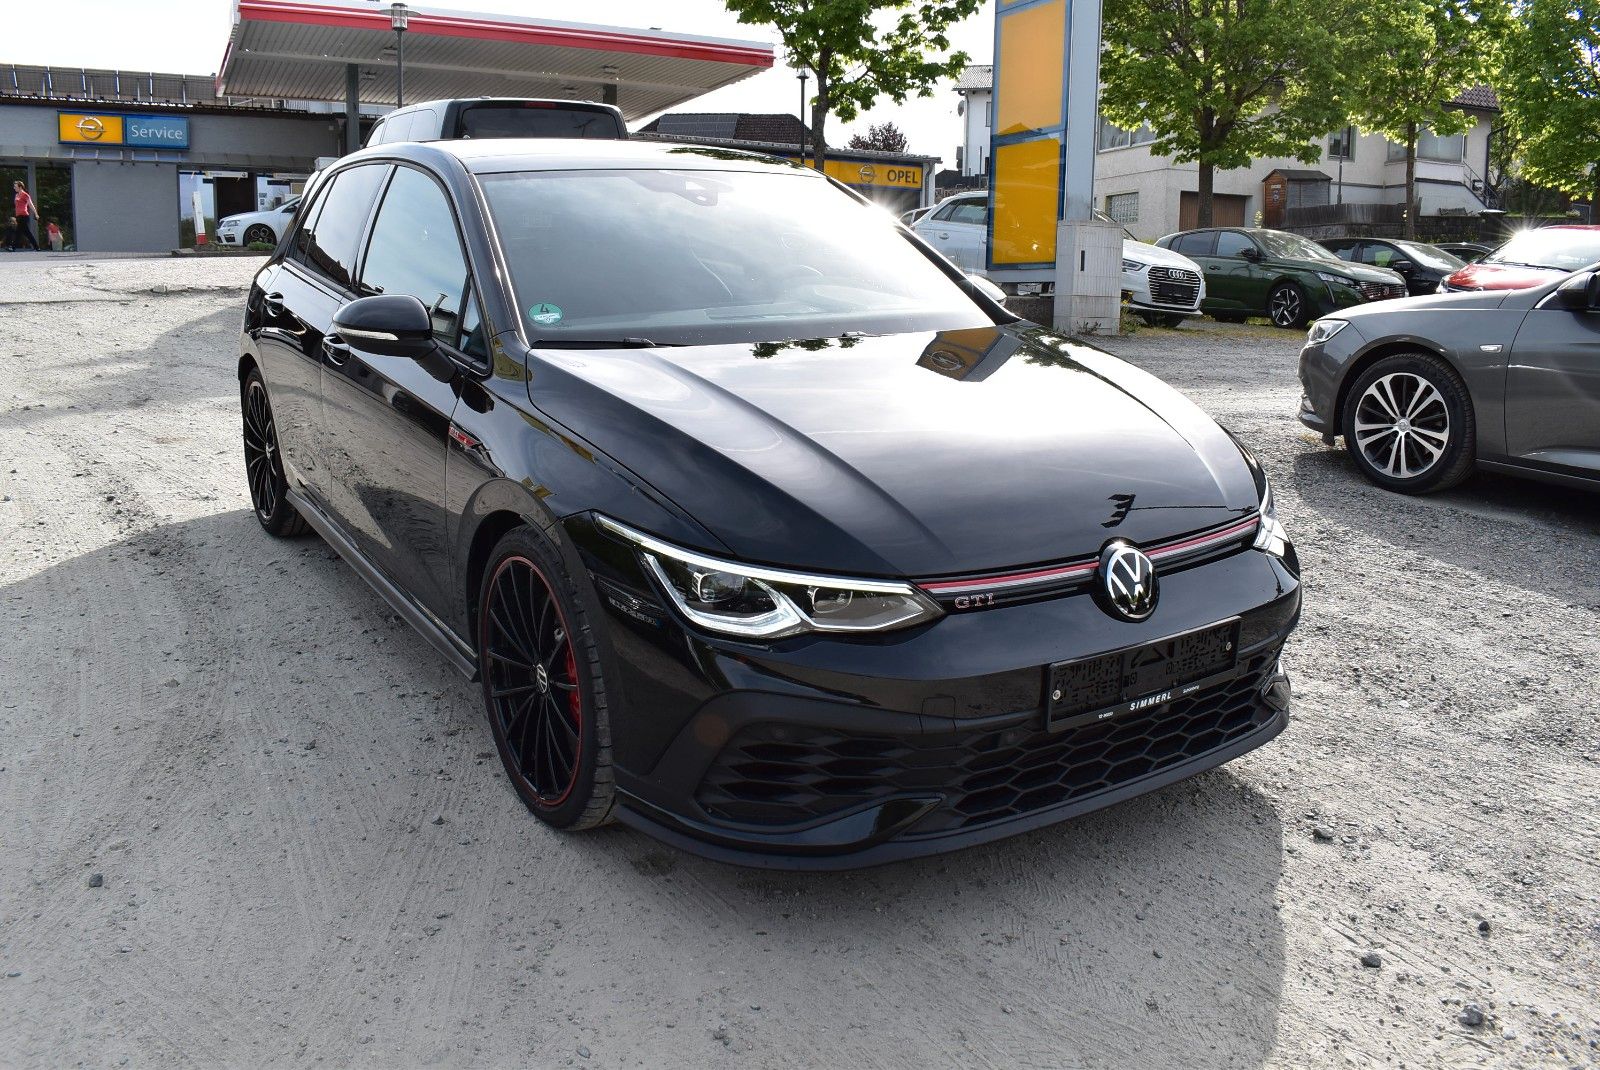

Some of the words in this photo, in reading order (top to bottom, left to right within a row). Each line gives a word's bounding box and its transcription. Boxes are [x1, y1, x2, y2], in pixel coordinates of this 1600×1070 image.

[130, 124, 184, 140] Service
[887, 169, 919, 184] OPEL
[540, 303, 550, 314] 4
[954, 592, 995, 609] GTI
[1129, 691, 1172, 711] SIMMERL
